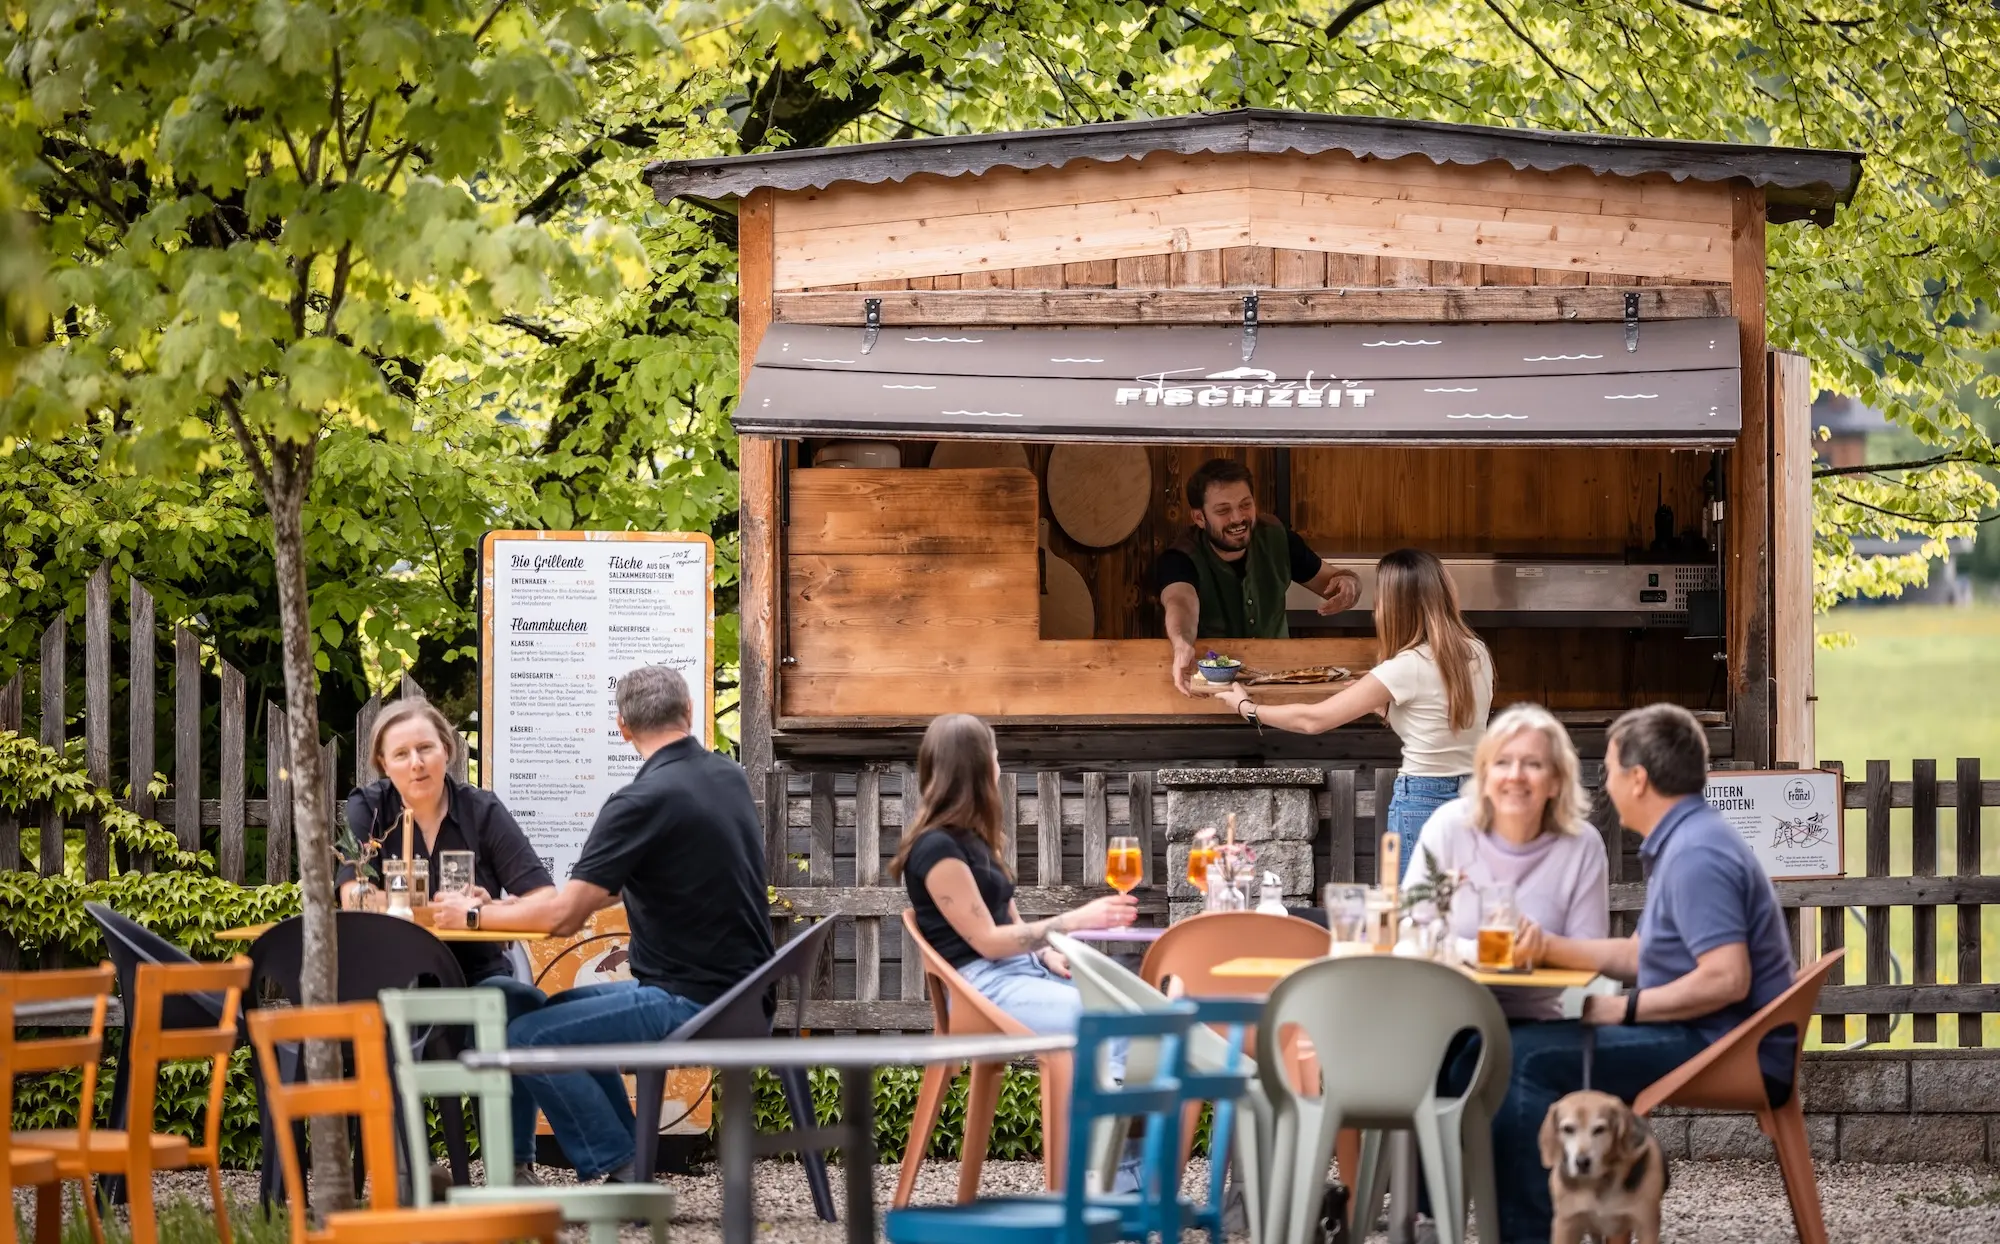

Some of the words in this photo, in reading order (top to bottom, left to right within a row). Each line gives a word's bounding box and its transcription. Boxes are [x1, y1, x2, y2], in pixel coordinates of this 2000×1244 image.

[1115, 388, 1375, 408] FISCHZEIT
[511, 554, 530, 568] Bio
[534, 554, 584, 573] Grillente
[608, 556, 643, 569] Fische
[510, 617, 588, 632] Flammkuchen
[510, 671, 554, 679] GEMÜSEGARTEN
[510, 725, 534, 733] KÄSEREI
[1705, 785, 1743, 798] ÜTTERN
[1788, 791, 1810, 800] Franzl
